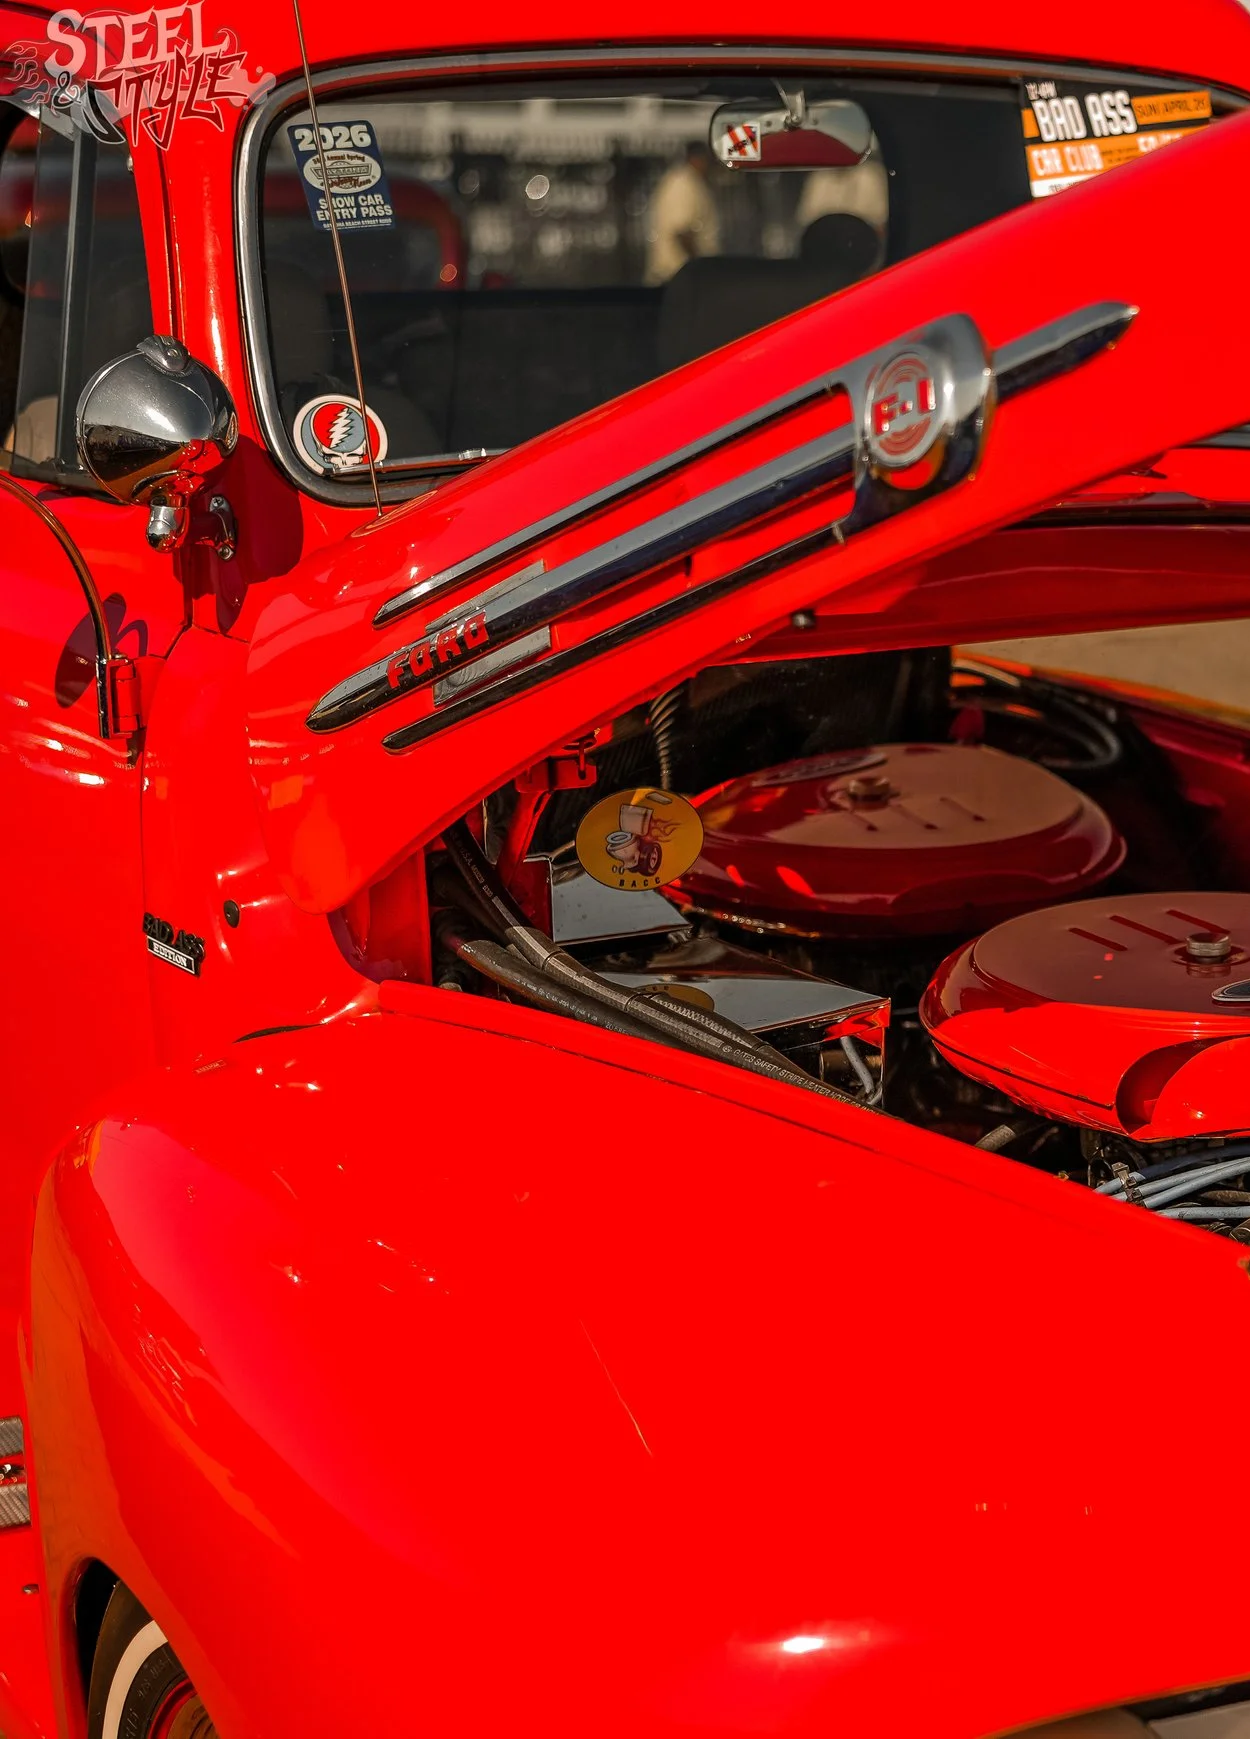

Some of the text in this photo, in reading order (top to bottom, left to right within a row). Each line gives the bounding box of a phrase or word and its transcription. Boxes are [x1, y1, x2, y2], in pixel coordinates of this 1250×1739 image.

[1032, 97, 1087, 141] BAD
[1084, 90, 1138, 137] ASS
[295, 125, 371, 151] 2026
[1031, 148, 1064, 176] CAR
[1063, 144, 1104, 173] CLUB
[358, 194, 384, 206] CAR
[361, 204, 393, 217] PASS
[386, 609, 490, 689] FORD
[619, 877, 660, 887] BACC
[152, 941, 188, 968] EDITION
[733, 1048, 756, 1064] GATES
[753, 1058, 780, 1074] SAFETY
[778, 1068, 806, 1085] STRIPE
[803, 1079, 831, 1096] HEATER
